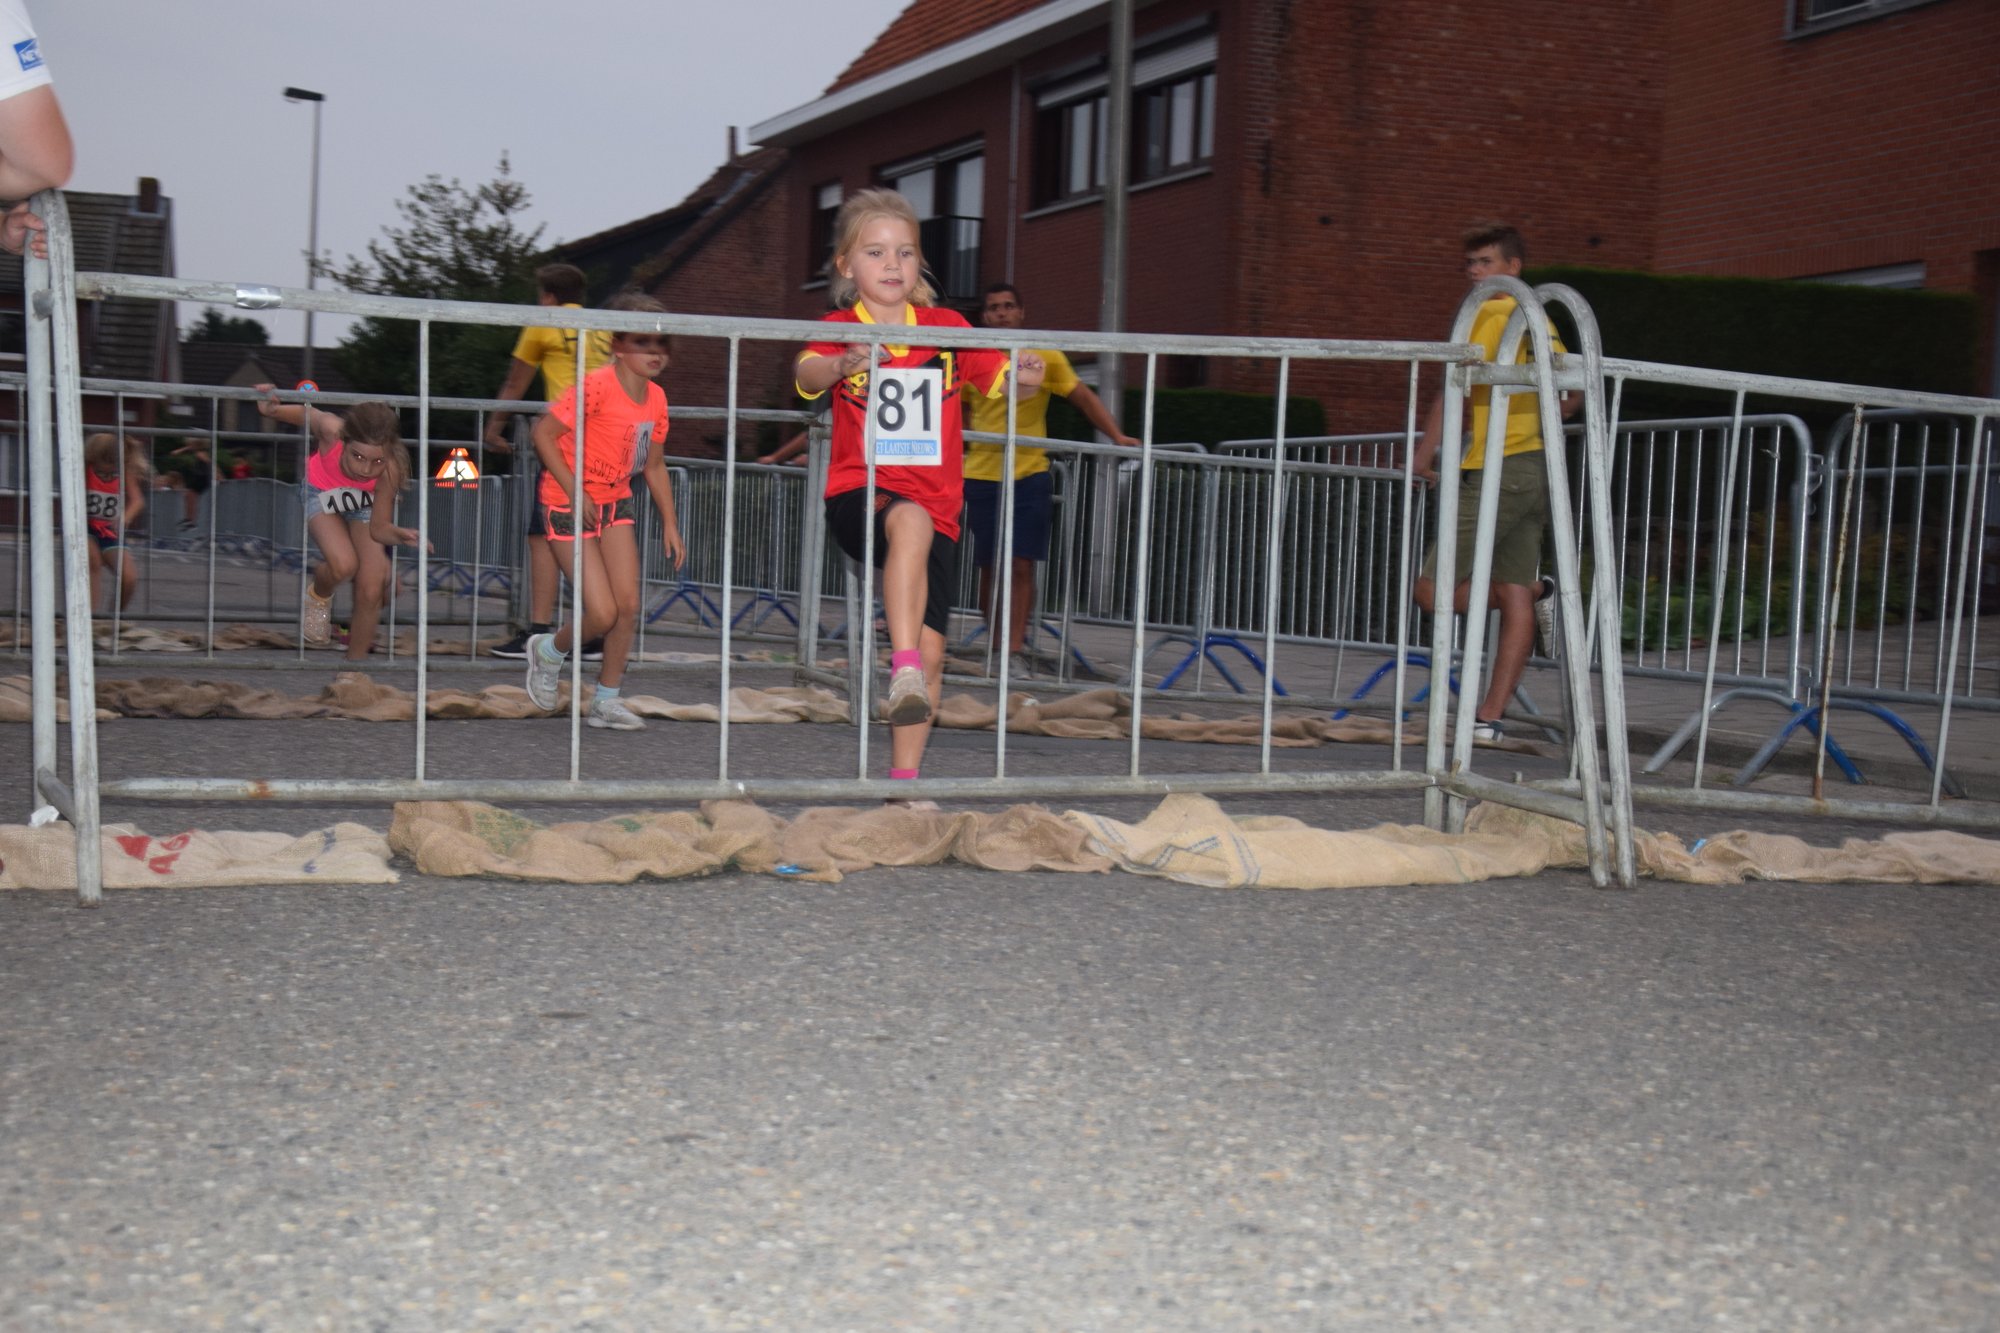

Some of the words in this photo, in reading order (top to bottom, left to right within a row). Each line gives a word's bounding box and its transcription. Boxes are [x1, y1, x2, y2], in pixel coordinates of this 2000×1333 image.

[877, 378, 931, 432] 81
[911, 440, 935, 455] NIEUWS
[326, 490, 374, 513] 104
